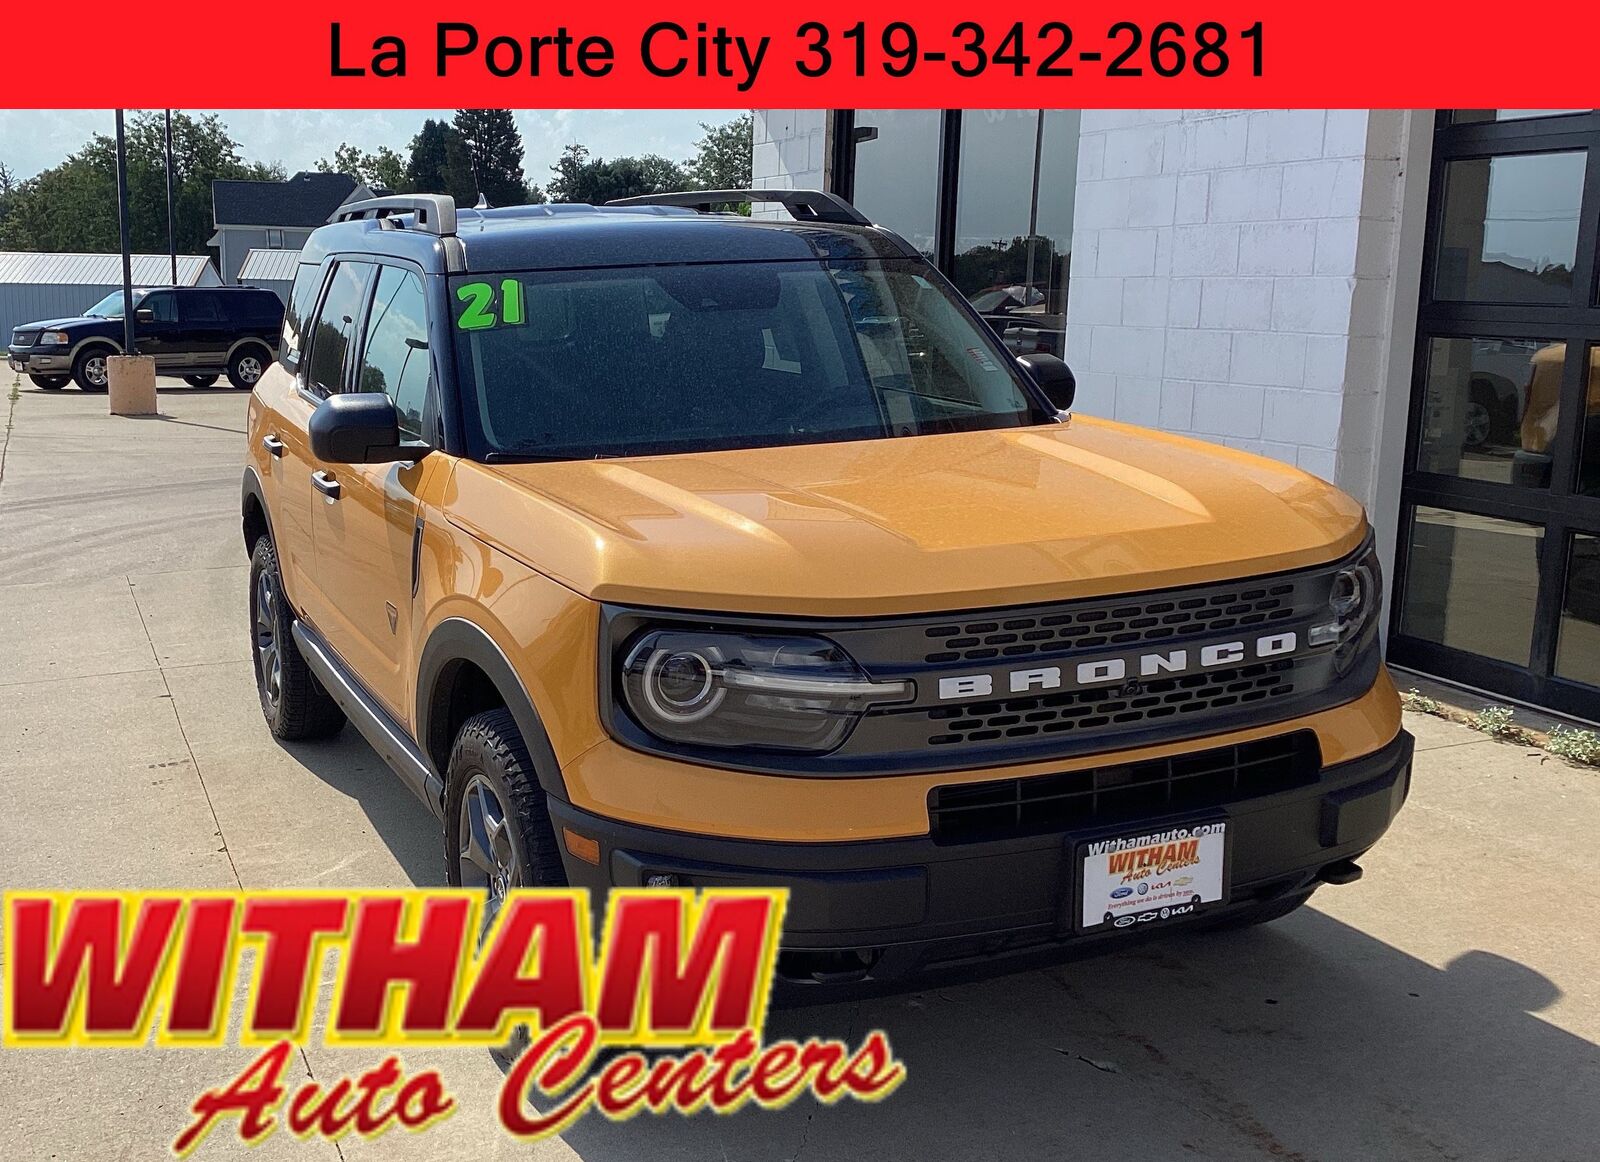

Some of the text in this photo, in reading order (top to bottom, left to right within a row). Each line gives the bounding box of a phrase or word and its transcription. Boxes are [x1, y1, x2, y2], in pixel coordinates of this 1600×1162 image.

[456, 279, 525, 330] 21
[938, 631, 1297, 699] BRONCO
[1109, 838, 1200, 874] WITHAM
[1120, 855, 1201, 885] Auto Centers
